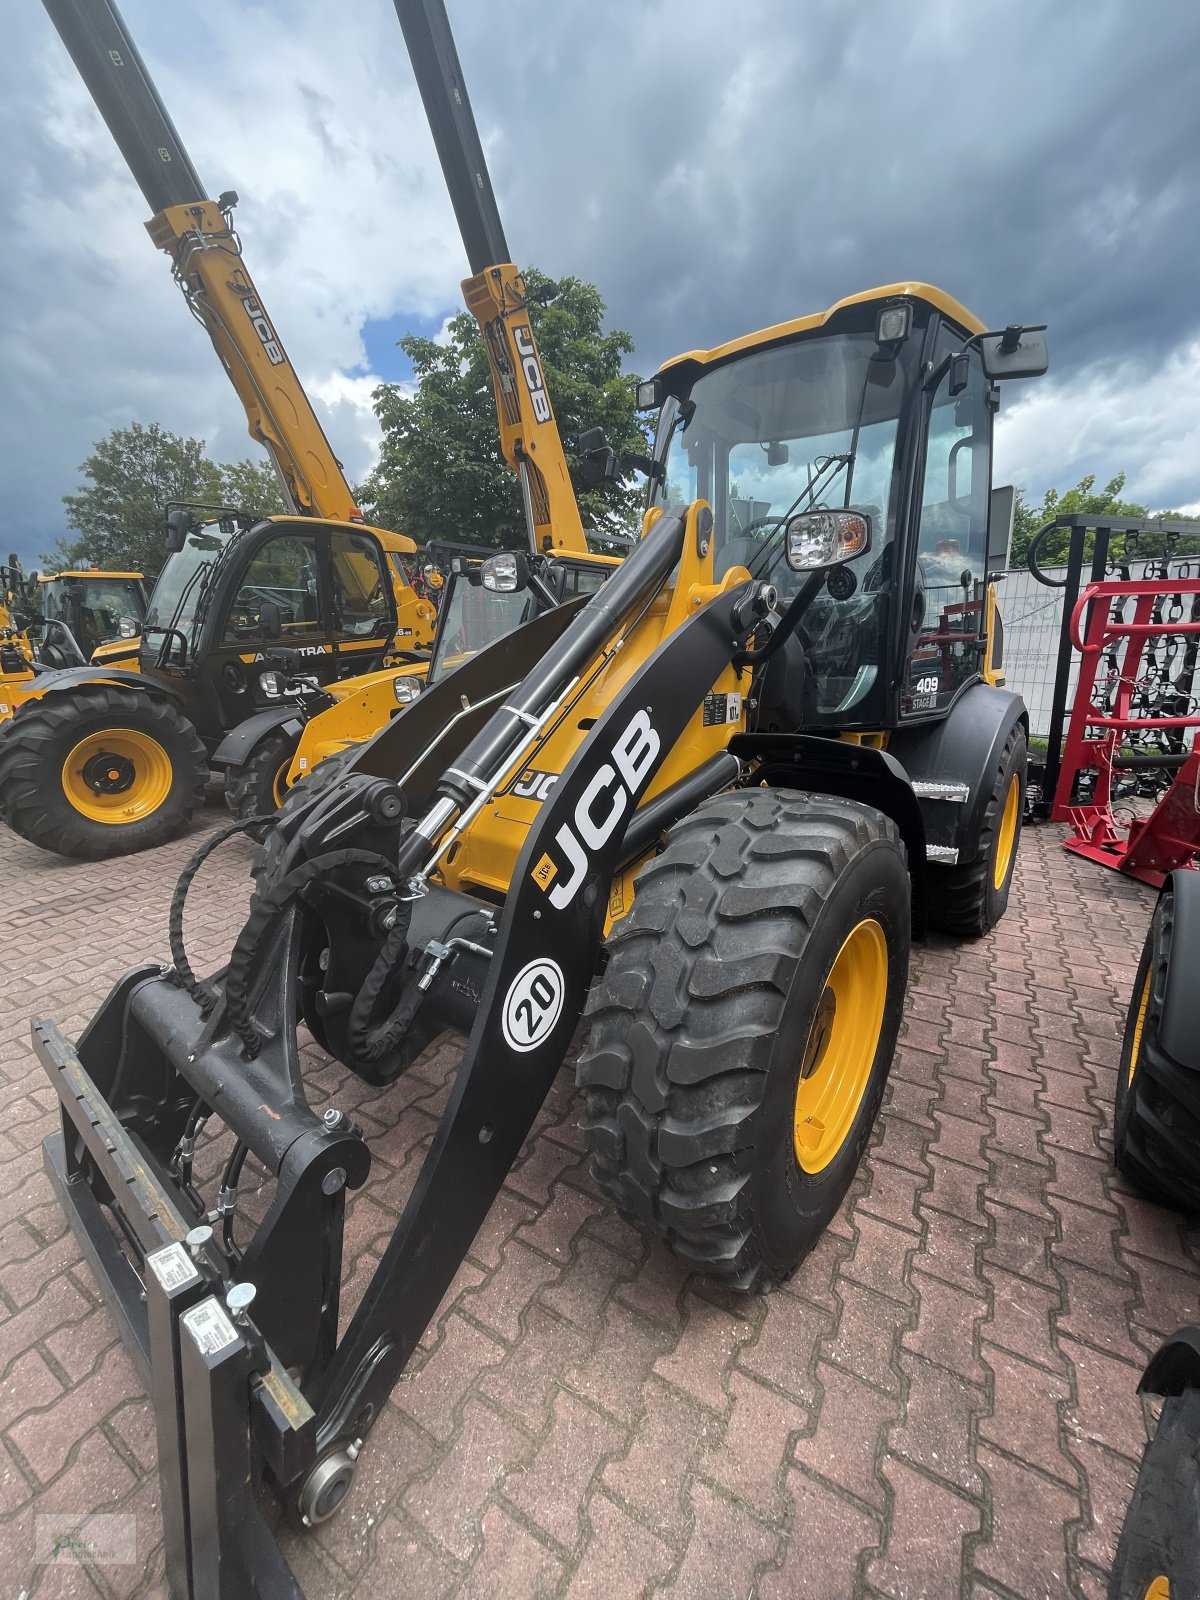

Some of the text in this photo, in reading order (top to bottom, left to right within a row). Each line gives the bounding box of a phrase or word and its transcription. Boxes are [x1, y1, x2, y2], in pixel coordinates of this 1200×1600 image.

[243, 299, 283, 365] JCB
[514, 328, 550, 422] JCB
[912, 697, 929, 709] STAGE
[917, 677, 938, 693] 409
[514, 773, 559, 800] JC
[548, 709, 660, 910] JCB
[539, 863, 550, 880] JCB
[515, 974, 555, 1038] 20
